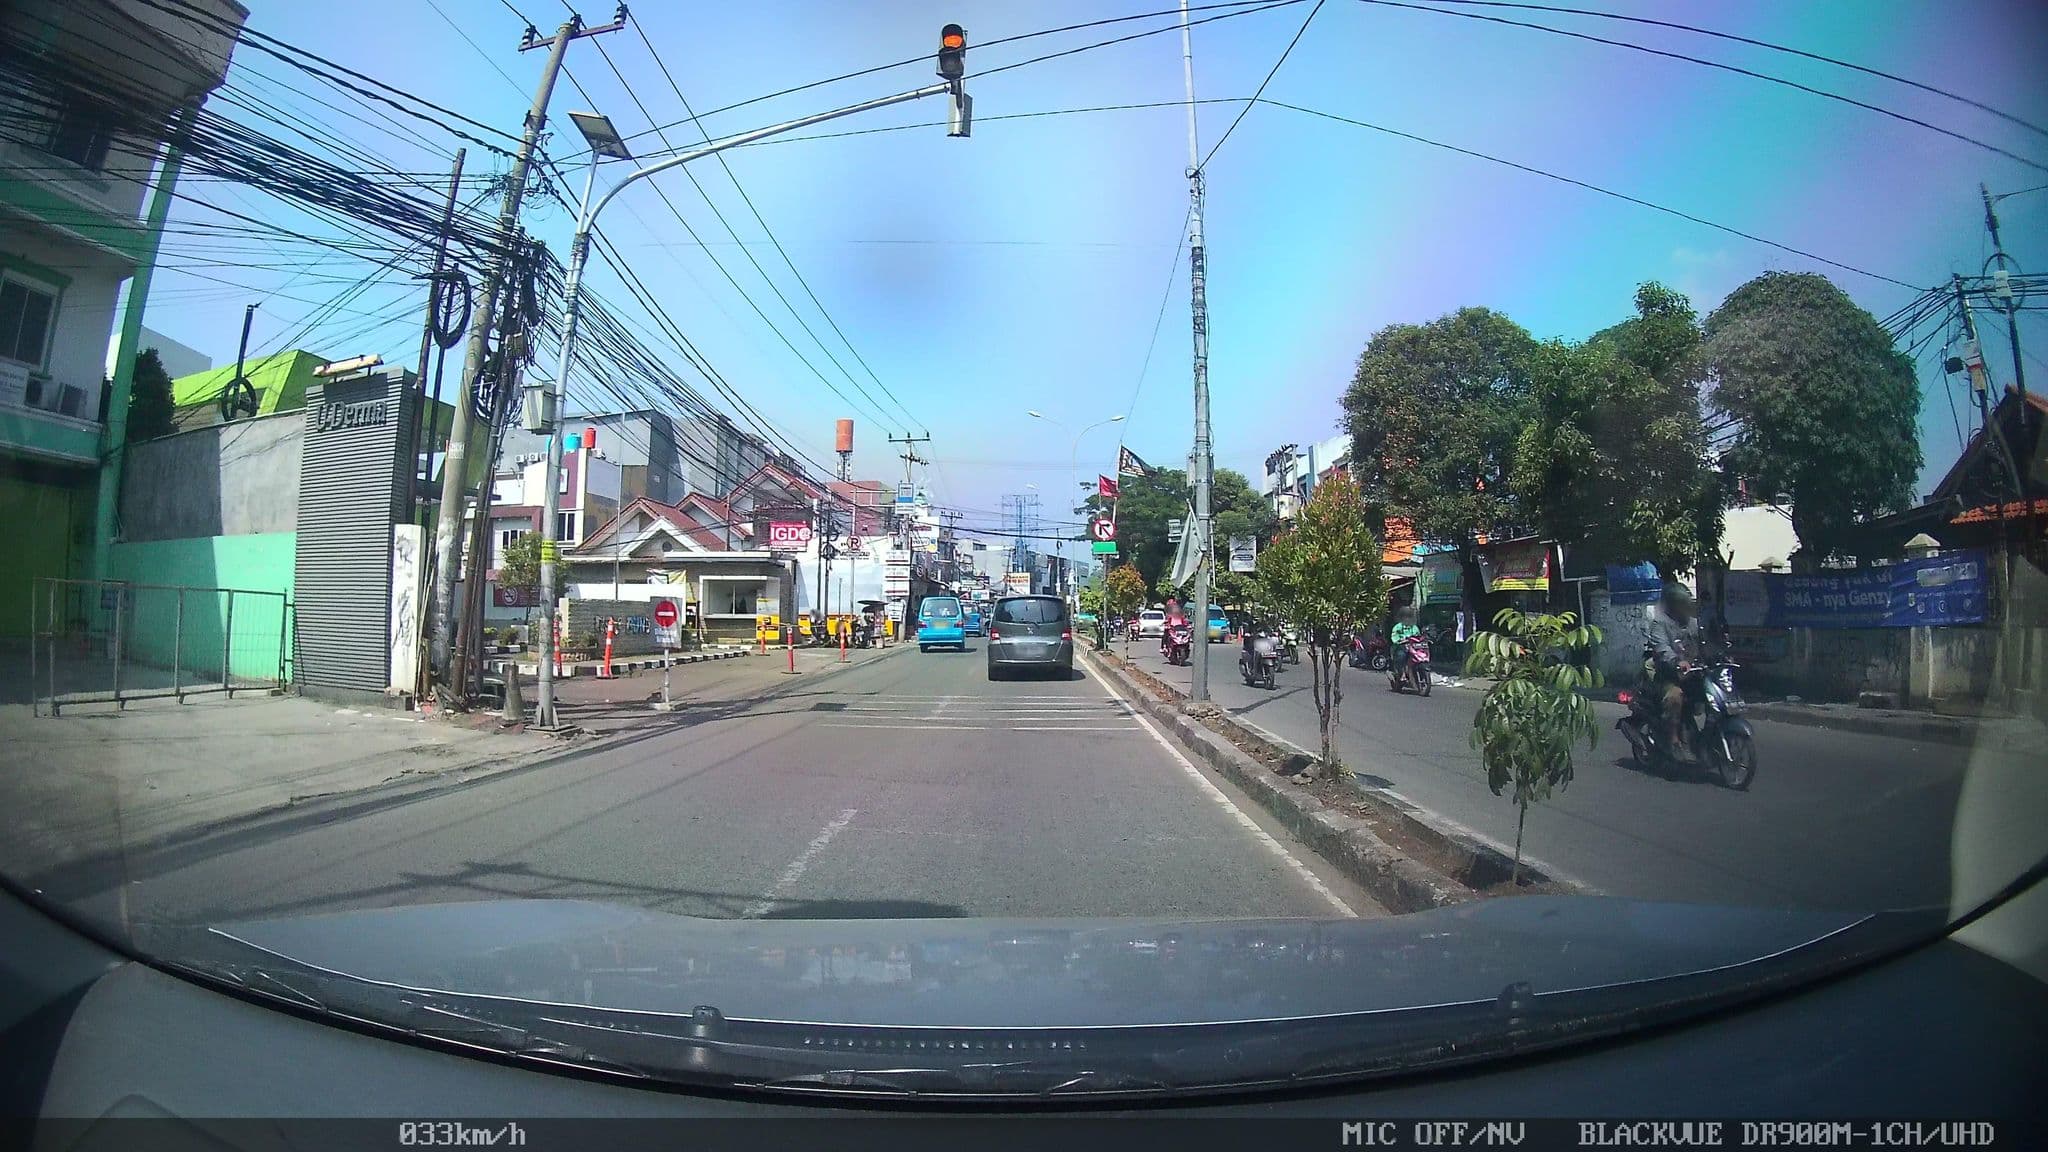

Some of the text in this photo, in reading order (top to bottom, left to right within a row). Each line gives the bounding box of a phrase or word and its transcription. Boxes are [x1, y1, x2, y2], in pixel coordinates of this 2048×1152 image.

[1784, 591, 1812, 608] SMA
[1823, 593, 1846, 611] nya
[1848, 590, 1892, 609] Genzy
